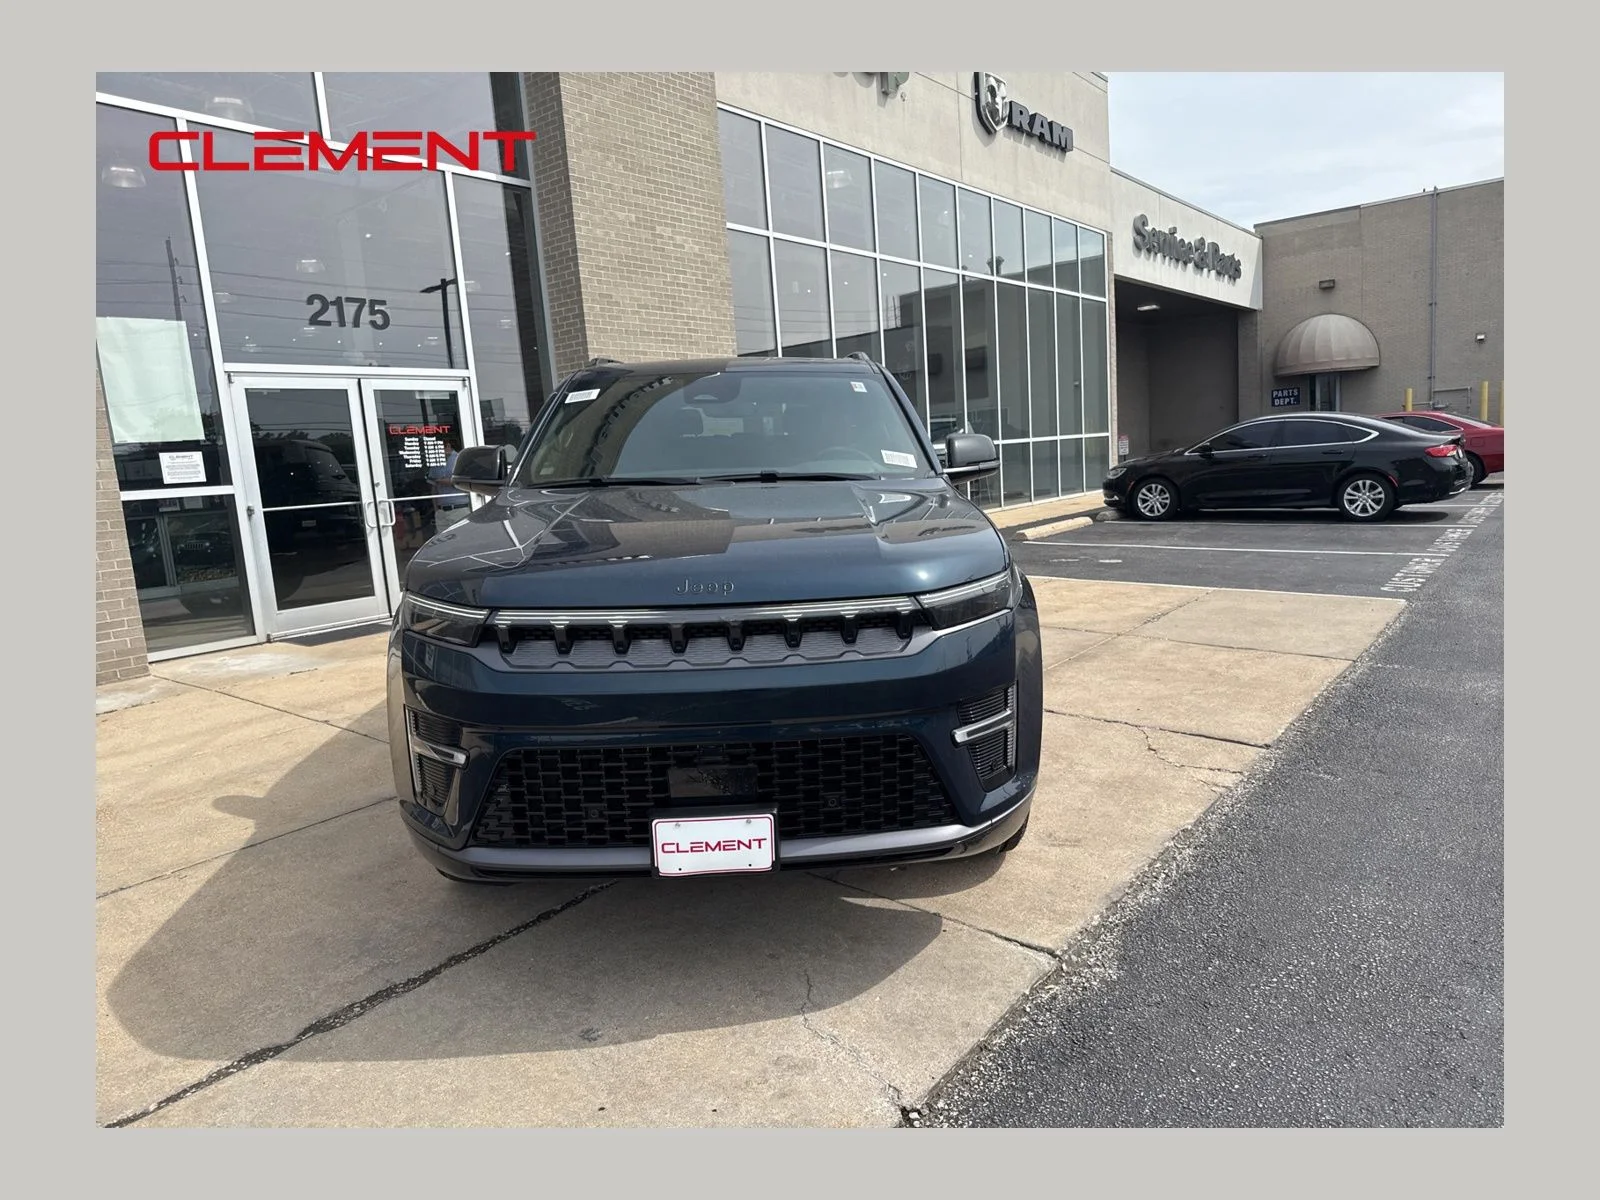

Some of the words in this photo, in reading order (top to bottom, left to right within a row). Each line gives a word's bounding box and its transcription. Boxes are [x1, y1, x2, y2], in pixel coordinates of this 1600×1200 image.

[1007, 101, 1074, 151] RAM
[1132, 214, 1194, 264] Service
[1207, 242, 1241, 279] Parts
[306, 294, 390, 330] 2175
[1272, 389, 1298, 398] PARTS
[1274, 397, 1297, 406] DEPT.
[389, 425, 450, 435] CLEMENT
[676, 579, 735, 597] Jeep
[661, 838, 767, 854] CLEMENT
